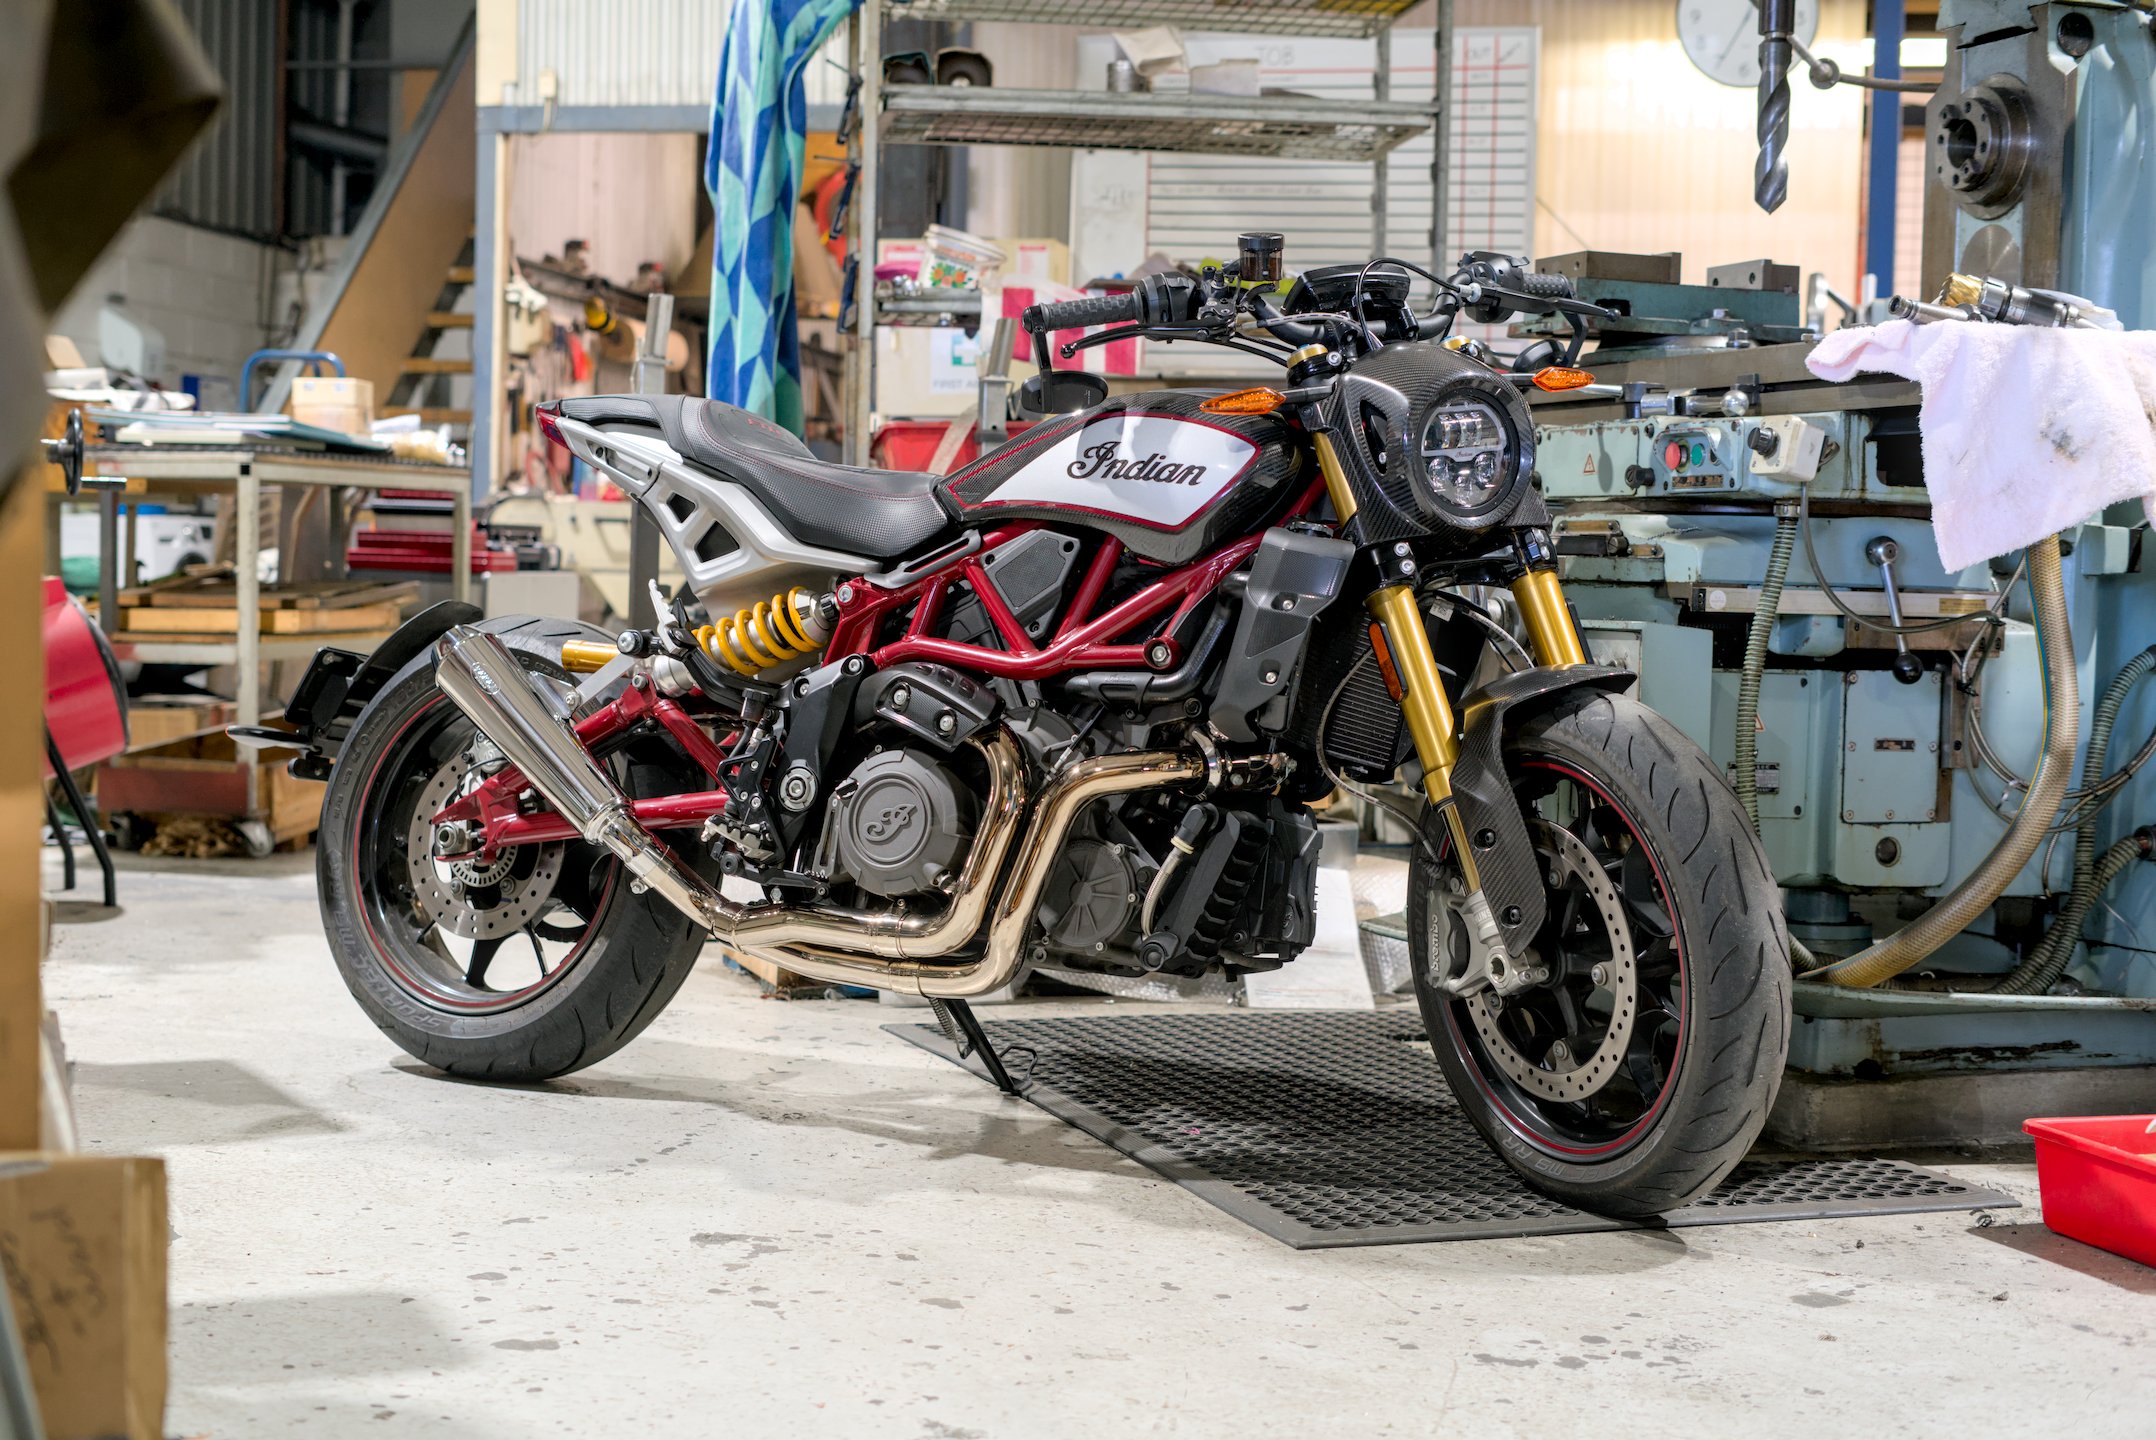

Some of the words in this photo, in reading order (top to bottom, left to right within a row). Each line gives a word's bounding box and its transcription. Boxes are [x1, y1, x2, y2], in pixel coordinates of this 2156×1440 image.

[1067, 441, 1207, 486] Indian
[1430, 914, 1439, 972] brembo
[1502, 1135, 1531, 1160] RR
